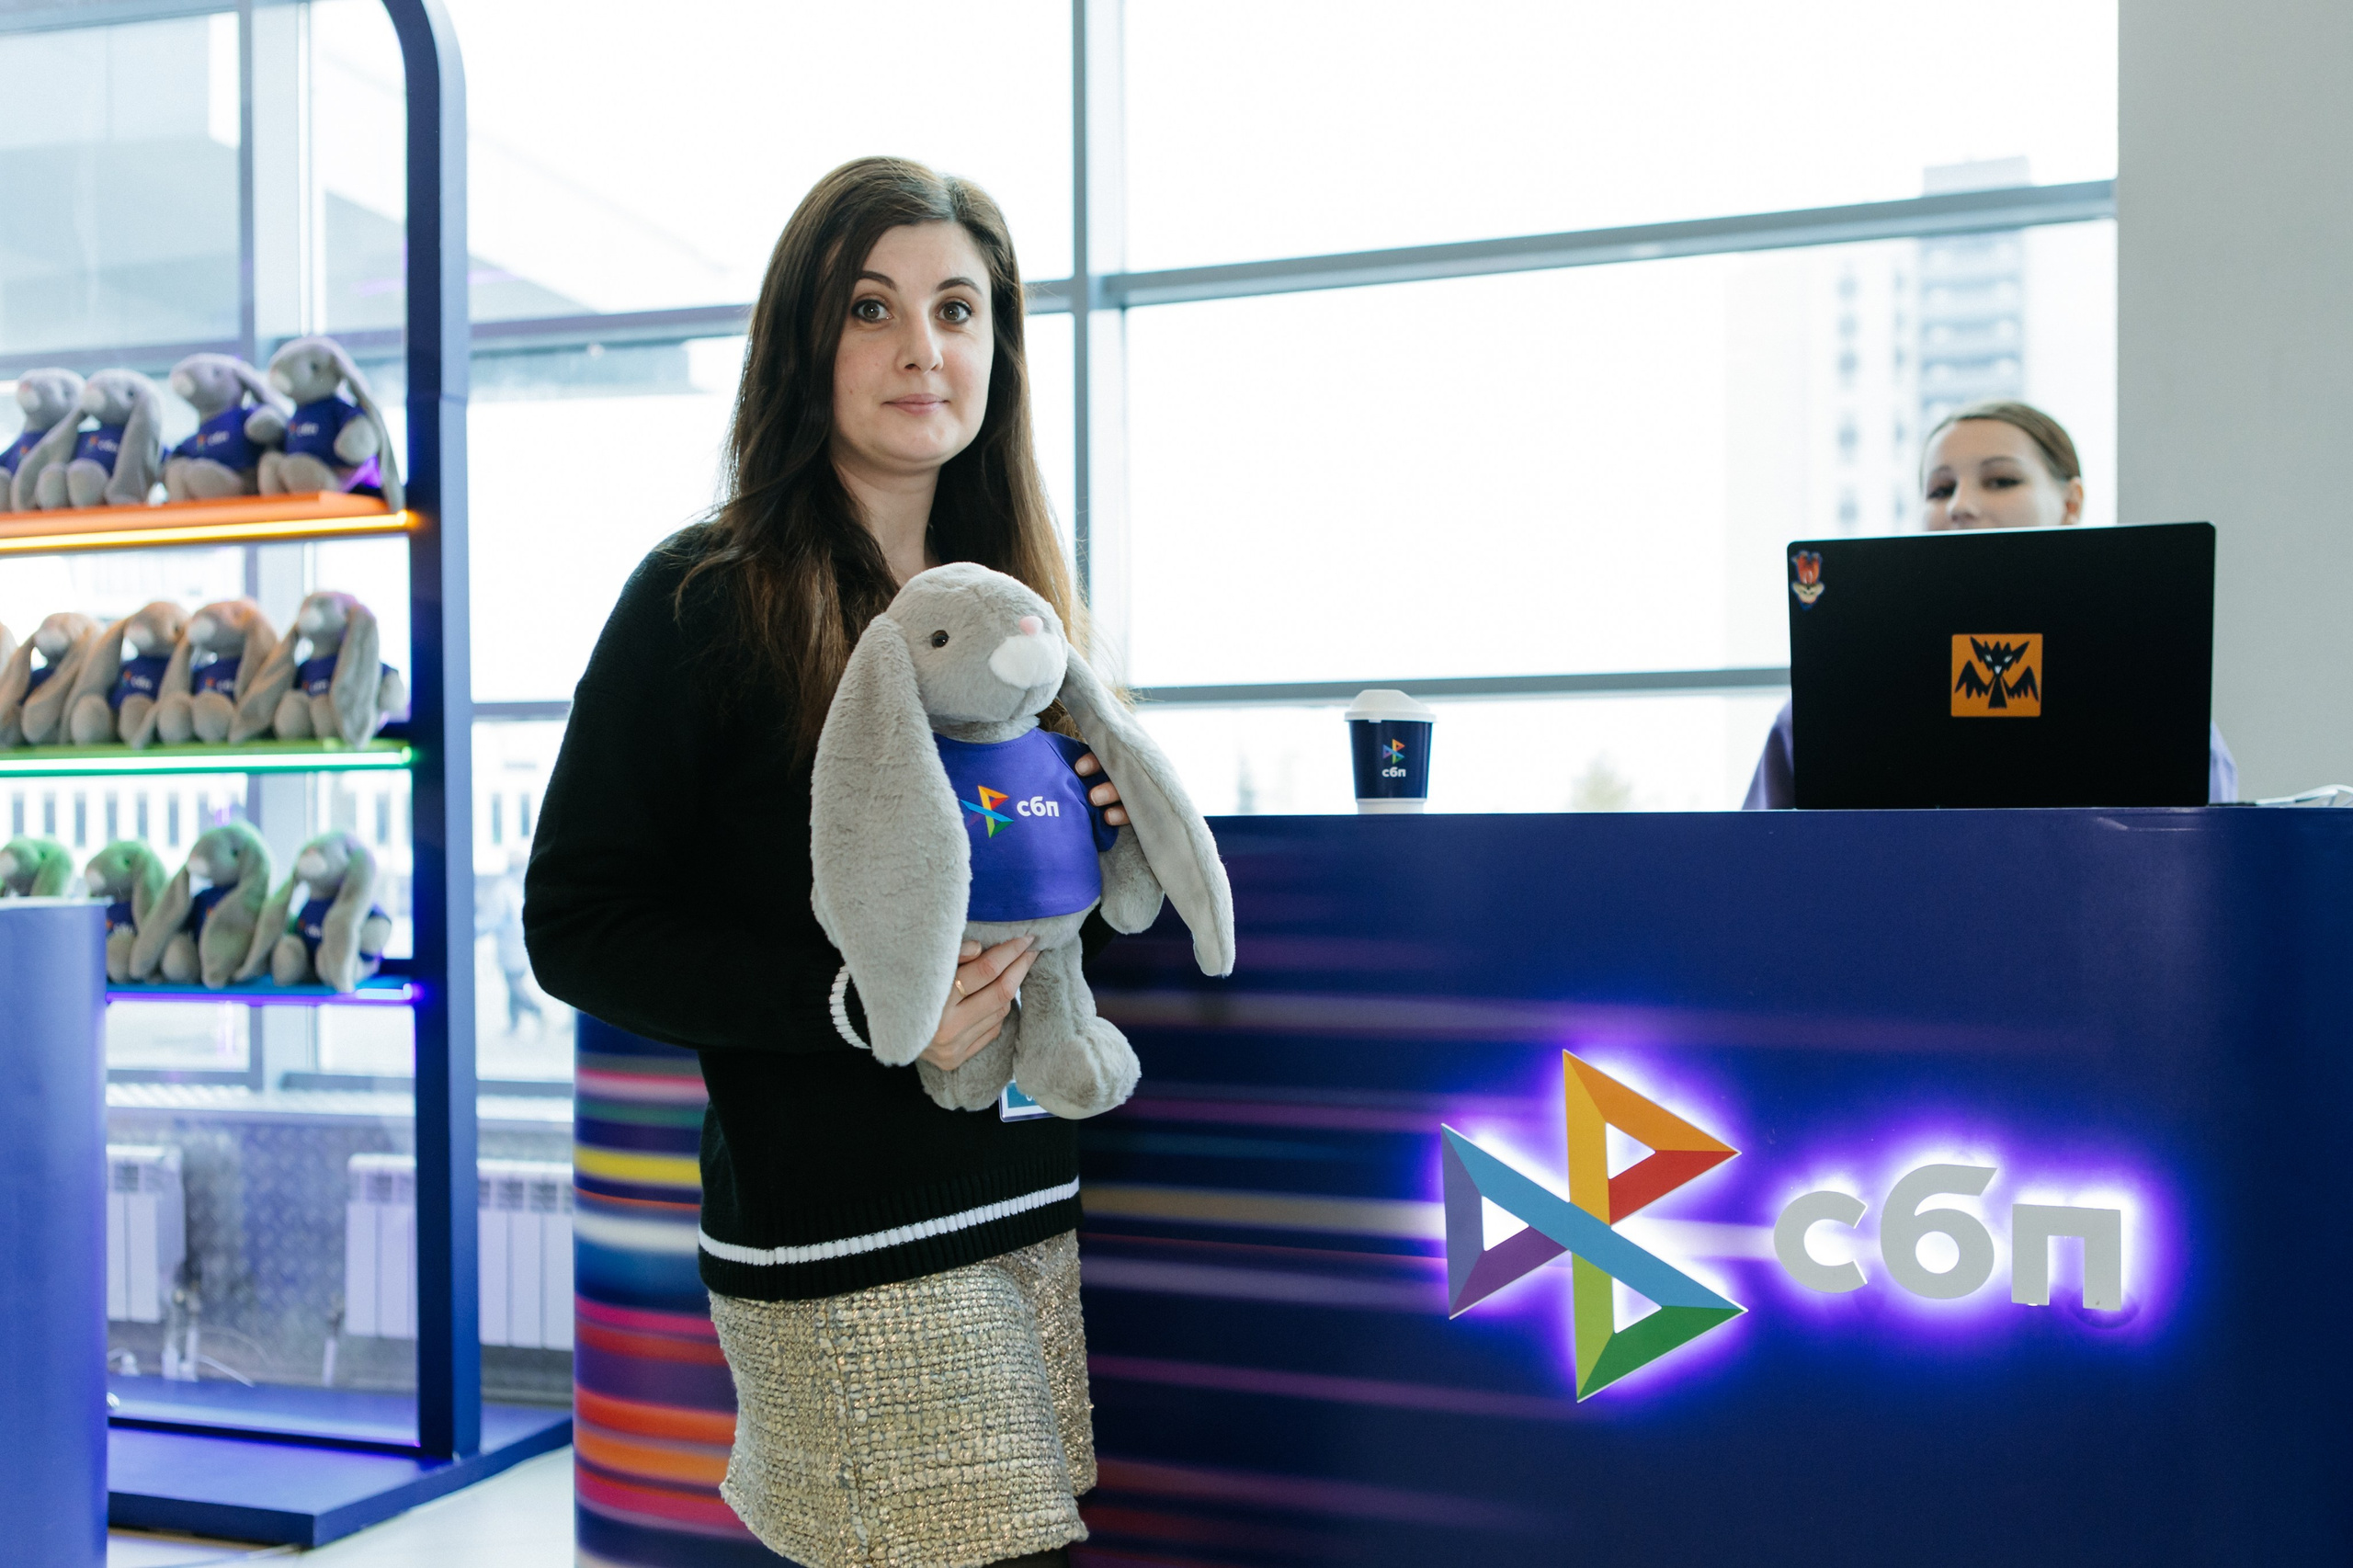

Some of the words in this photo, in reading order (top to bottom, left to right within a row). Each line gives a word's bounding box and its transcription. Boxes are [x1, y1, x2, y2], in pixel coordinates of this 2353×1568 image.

[1381, 767, 1407, 778] сбп
[1016, 796, 1060, 817] сбп
[1773, 1163, 2122, 1312] сбп
